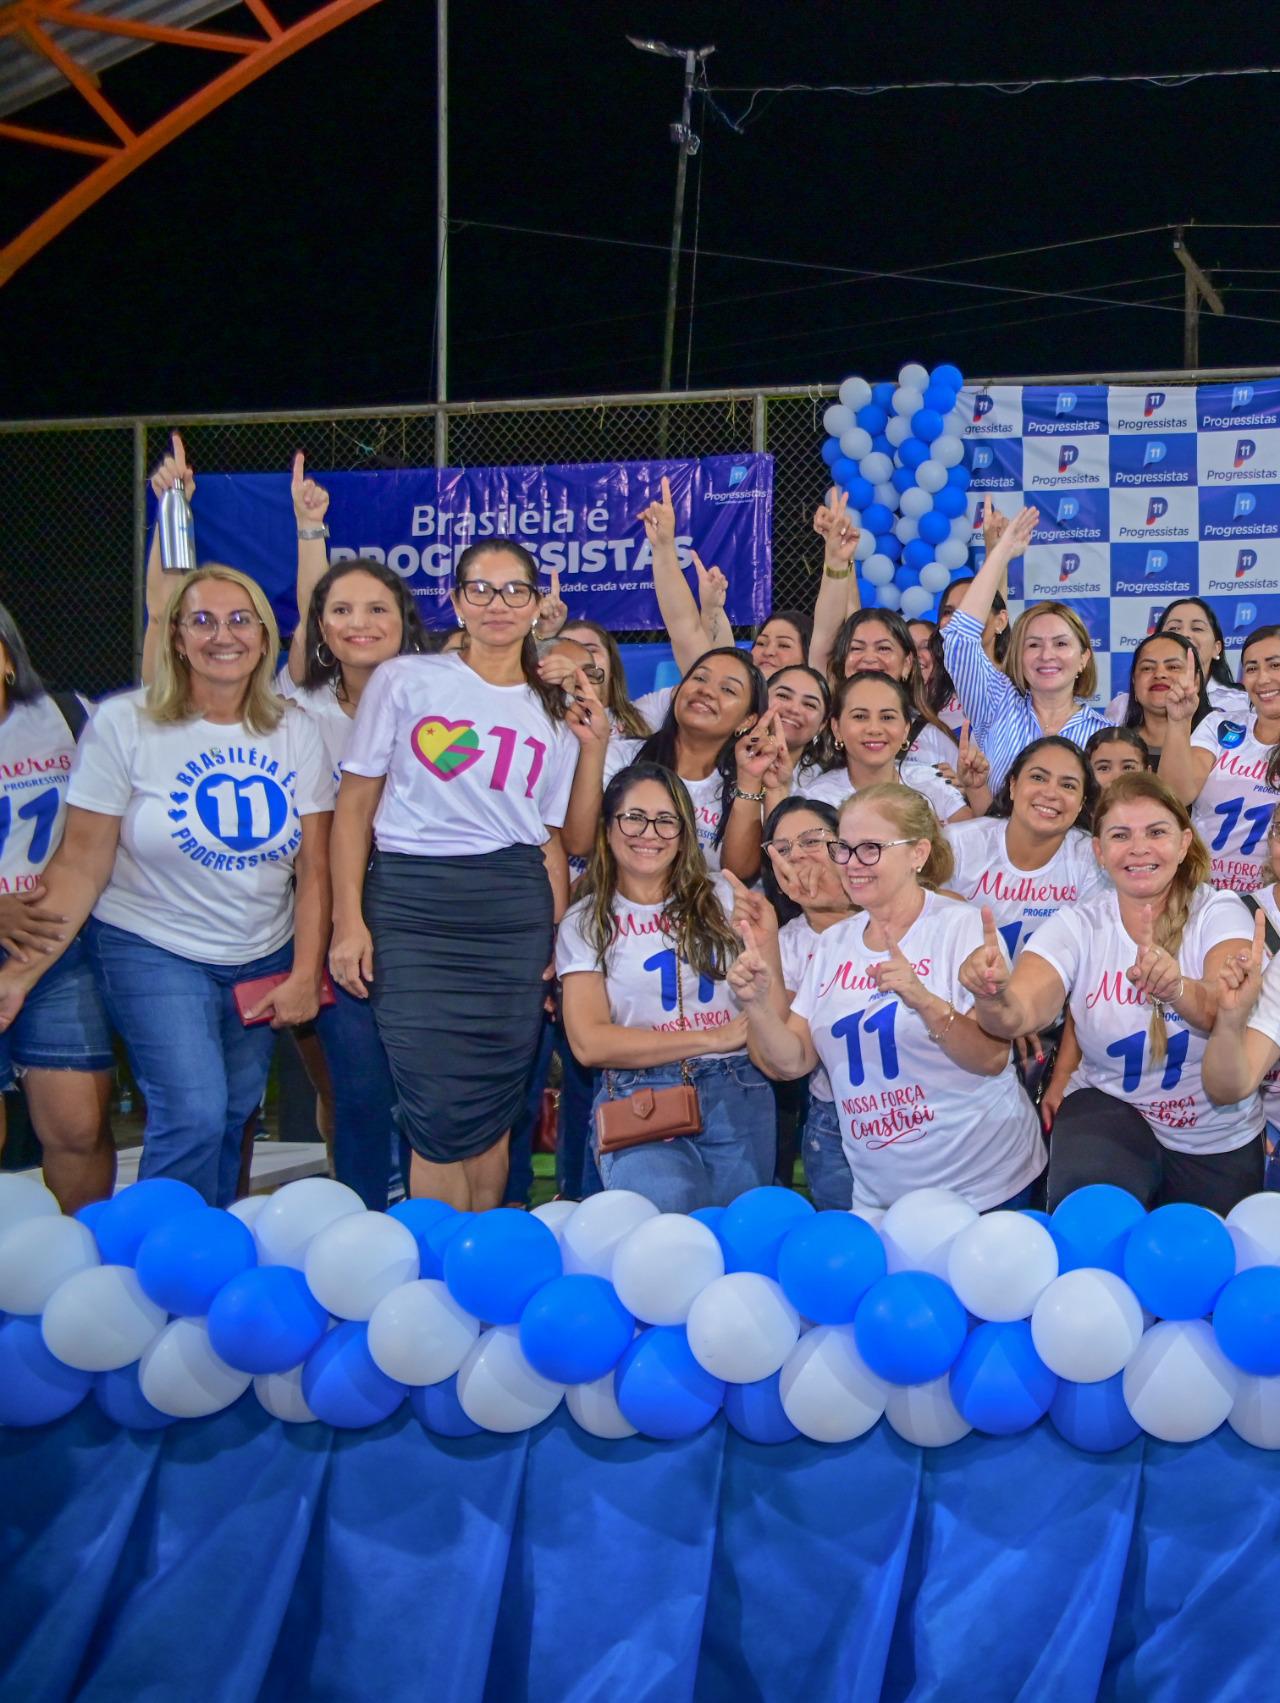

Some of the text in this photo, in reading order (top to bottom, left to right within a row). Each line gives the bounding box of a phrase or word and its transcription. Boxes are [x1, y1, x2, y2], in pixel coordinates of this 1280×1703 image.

[1027, 420, 1100, 433] Progressistas
[1117, 418, 1187, 430] Progressistas
[1203, 414, 1277, 427] Progressistas
[964, 423, 1013, 436] gressistas
[1031, 473, 1100, 486] Progressistas
[1115, 471, 1188, 484] Progressistas
[1206, 469, 1278, 481] Progressistas
[969, 477, 1015, 487] ressistas
[704, 489, 767, 501] Progressistas
[411, 500, 609, 537] Brasiléia é
[1030, 528, 1101, 541] Progressistas
[1119, 526, 1189, 538] Progressistas
[1204, 523, 1278, 536] Progressistas
[591, 581, 617, 592] cada
[619, 582, 637, 590] vez
[1033, 582, 1101, 595] Progressistas
[1116, 580, 1190, 593] Progressistas
[1208, 578, 1278, 591] Progressistas
[177, 747, 278, 788] BRASILÉIA
[3, 775, 69, 792] PROGRESSIST
[206, 781, 271, 838] 11
[1211, 796, 1277, 856] 11
[171, 826, 303, 871] PROGRESSISTAS
[967, 870, 1077, 902] Mulheres
[831, 1001, 899, 1087] 11
[1106, 1029, 1190, 1093] 11
[842, 1084, 925, 1116] NOSSA FORÇA
[851, 1104, 934, 1141] Constrói
